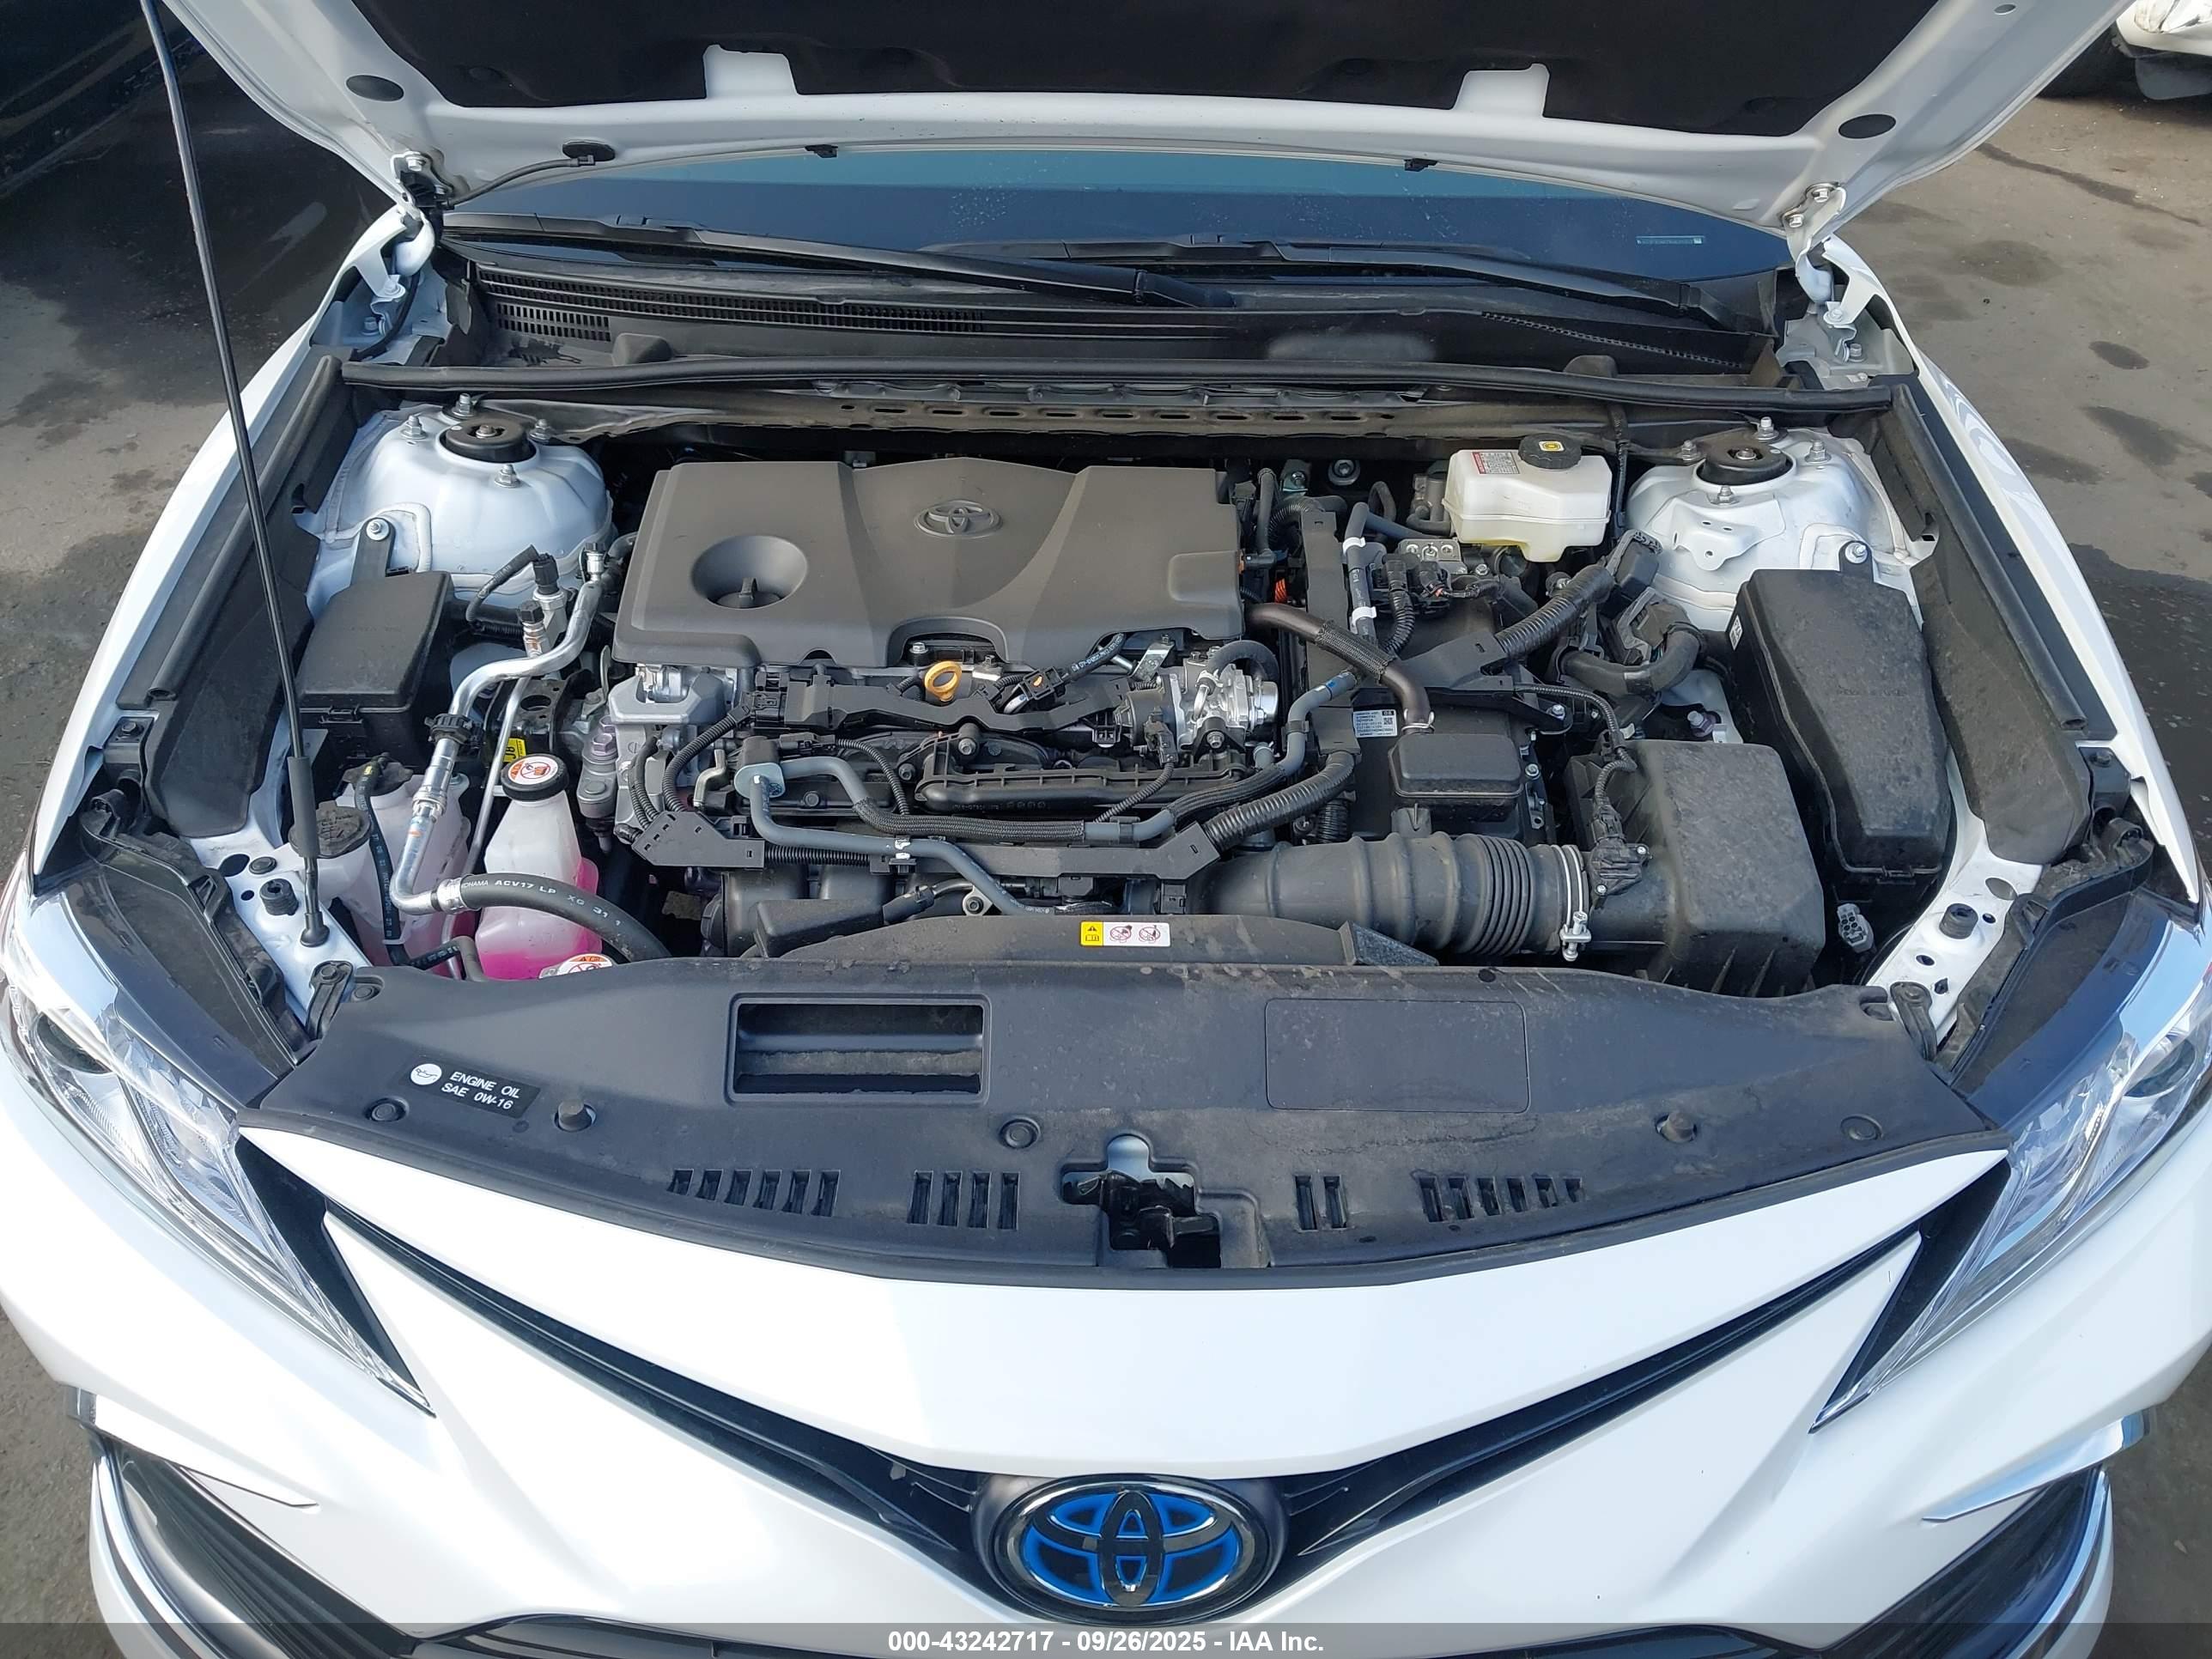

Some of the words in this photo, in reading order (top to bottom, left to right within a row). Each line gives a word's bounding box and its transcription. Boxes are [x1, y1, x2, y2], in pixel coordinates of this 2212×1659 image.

[494, 879, 535, 889] ACV17
[539, 885, 556, 894] LP
[441, 1082, 470, 1097] SAE
[473, 1091, 514, 1109] 0W-16
[449, 1071, 497, 1091] ENGINE
[501, 1085, 520, 1099] OIL
